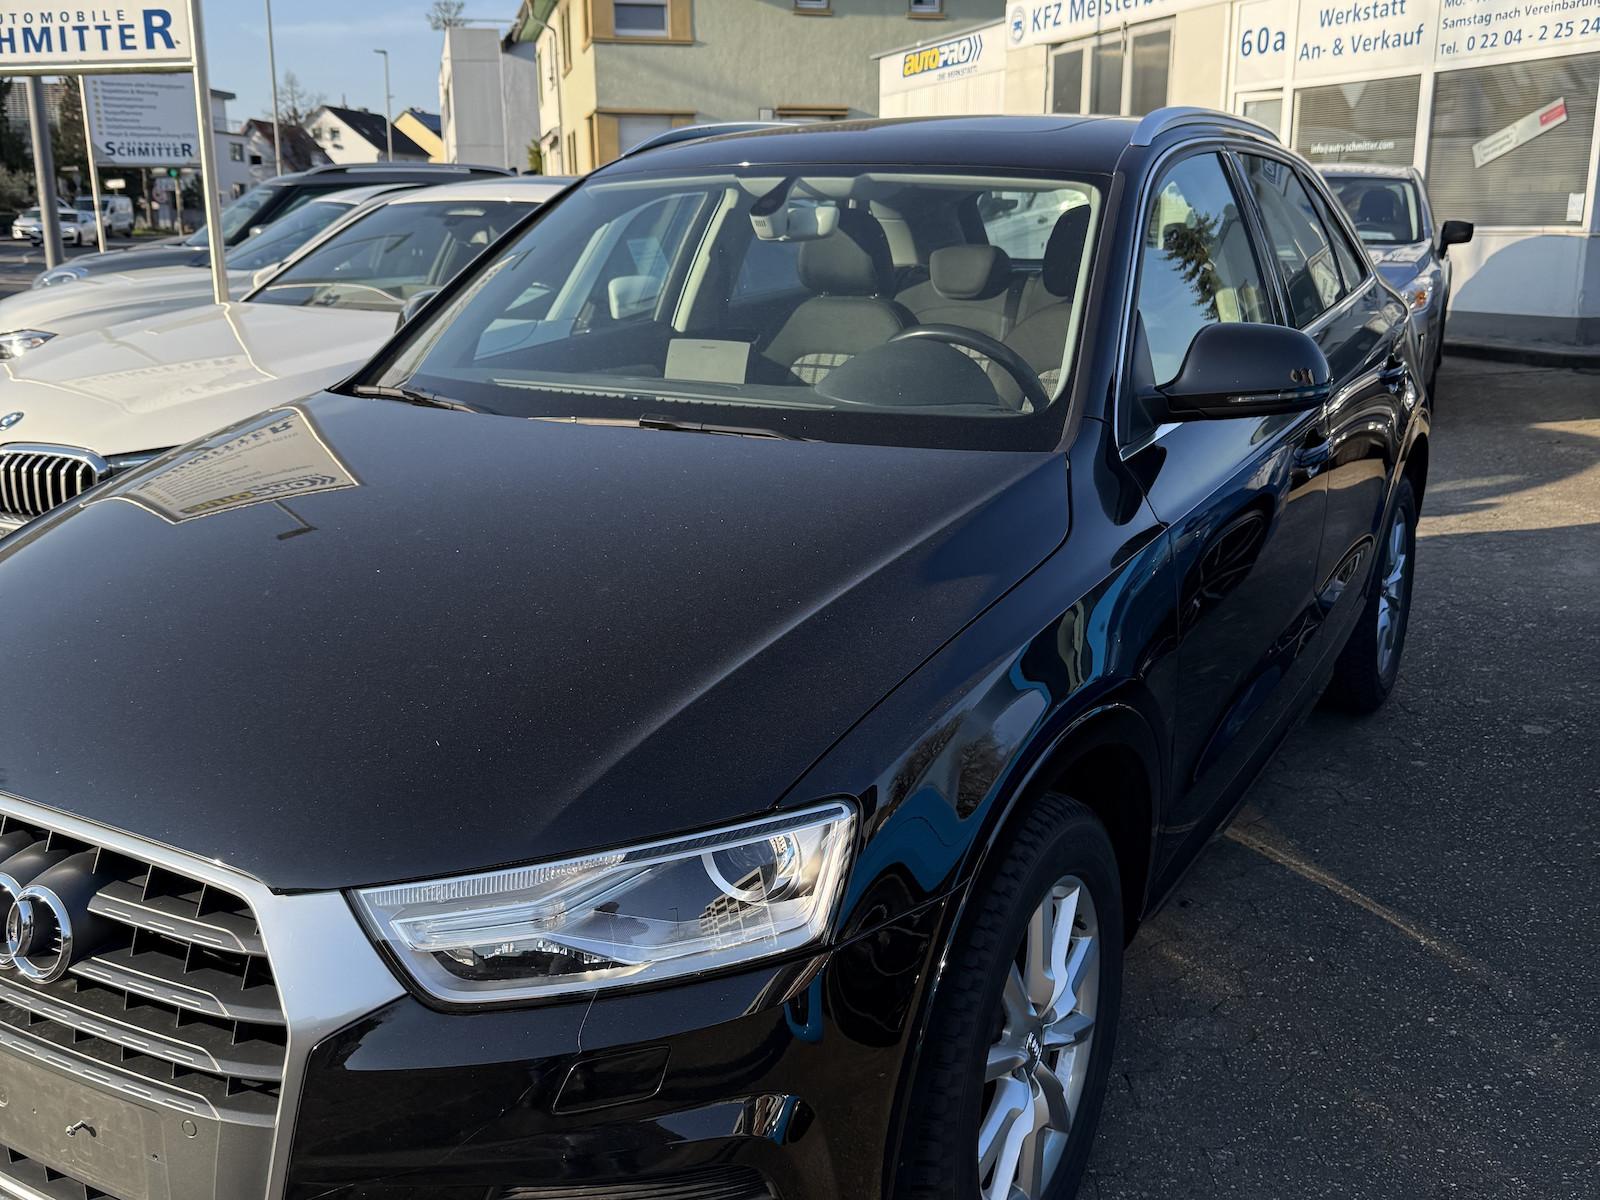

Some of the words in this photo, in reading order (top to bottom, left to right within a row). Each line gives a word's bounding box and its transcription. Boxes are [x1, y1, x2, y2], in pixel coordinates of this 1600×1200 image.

[1032, 2, 1062, 32] KFZ
[1319, 0, 1407, 27] Werkstatt
[1442, 13, 1492, 30] Samstag
[1495, 8, 1521, 21] nach
[1241, 26, 1286, 57] 60a
[1299, 43, 1326, 61] An-
[1332, 38, 1344, 56] &
[1351, 23, 1425, 53] Verkauf
[1440, 42, 1459, 55] Tel.
[1467, 36, 1476, 51] 0
[1480, 33, 1498, 49] 22
[1504, 29, 1522, 45] 04
[1538, 25, 1548, 41] 2
[1553, 21, 1575, 39] 25
[105, 141, 193, 157] SCHMITTER
